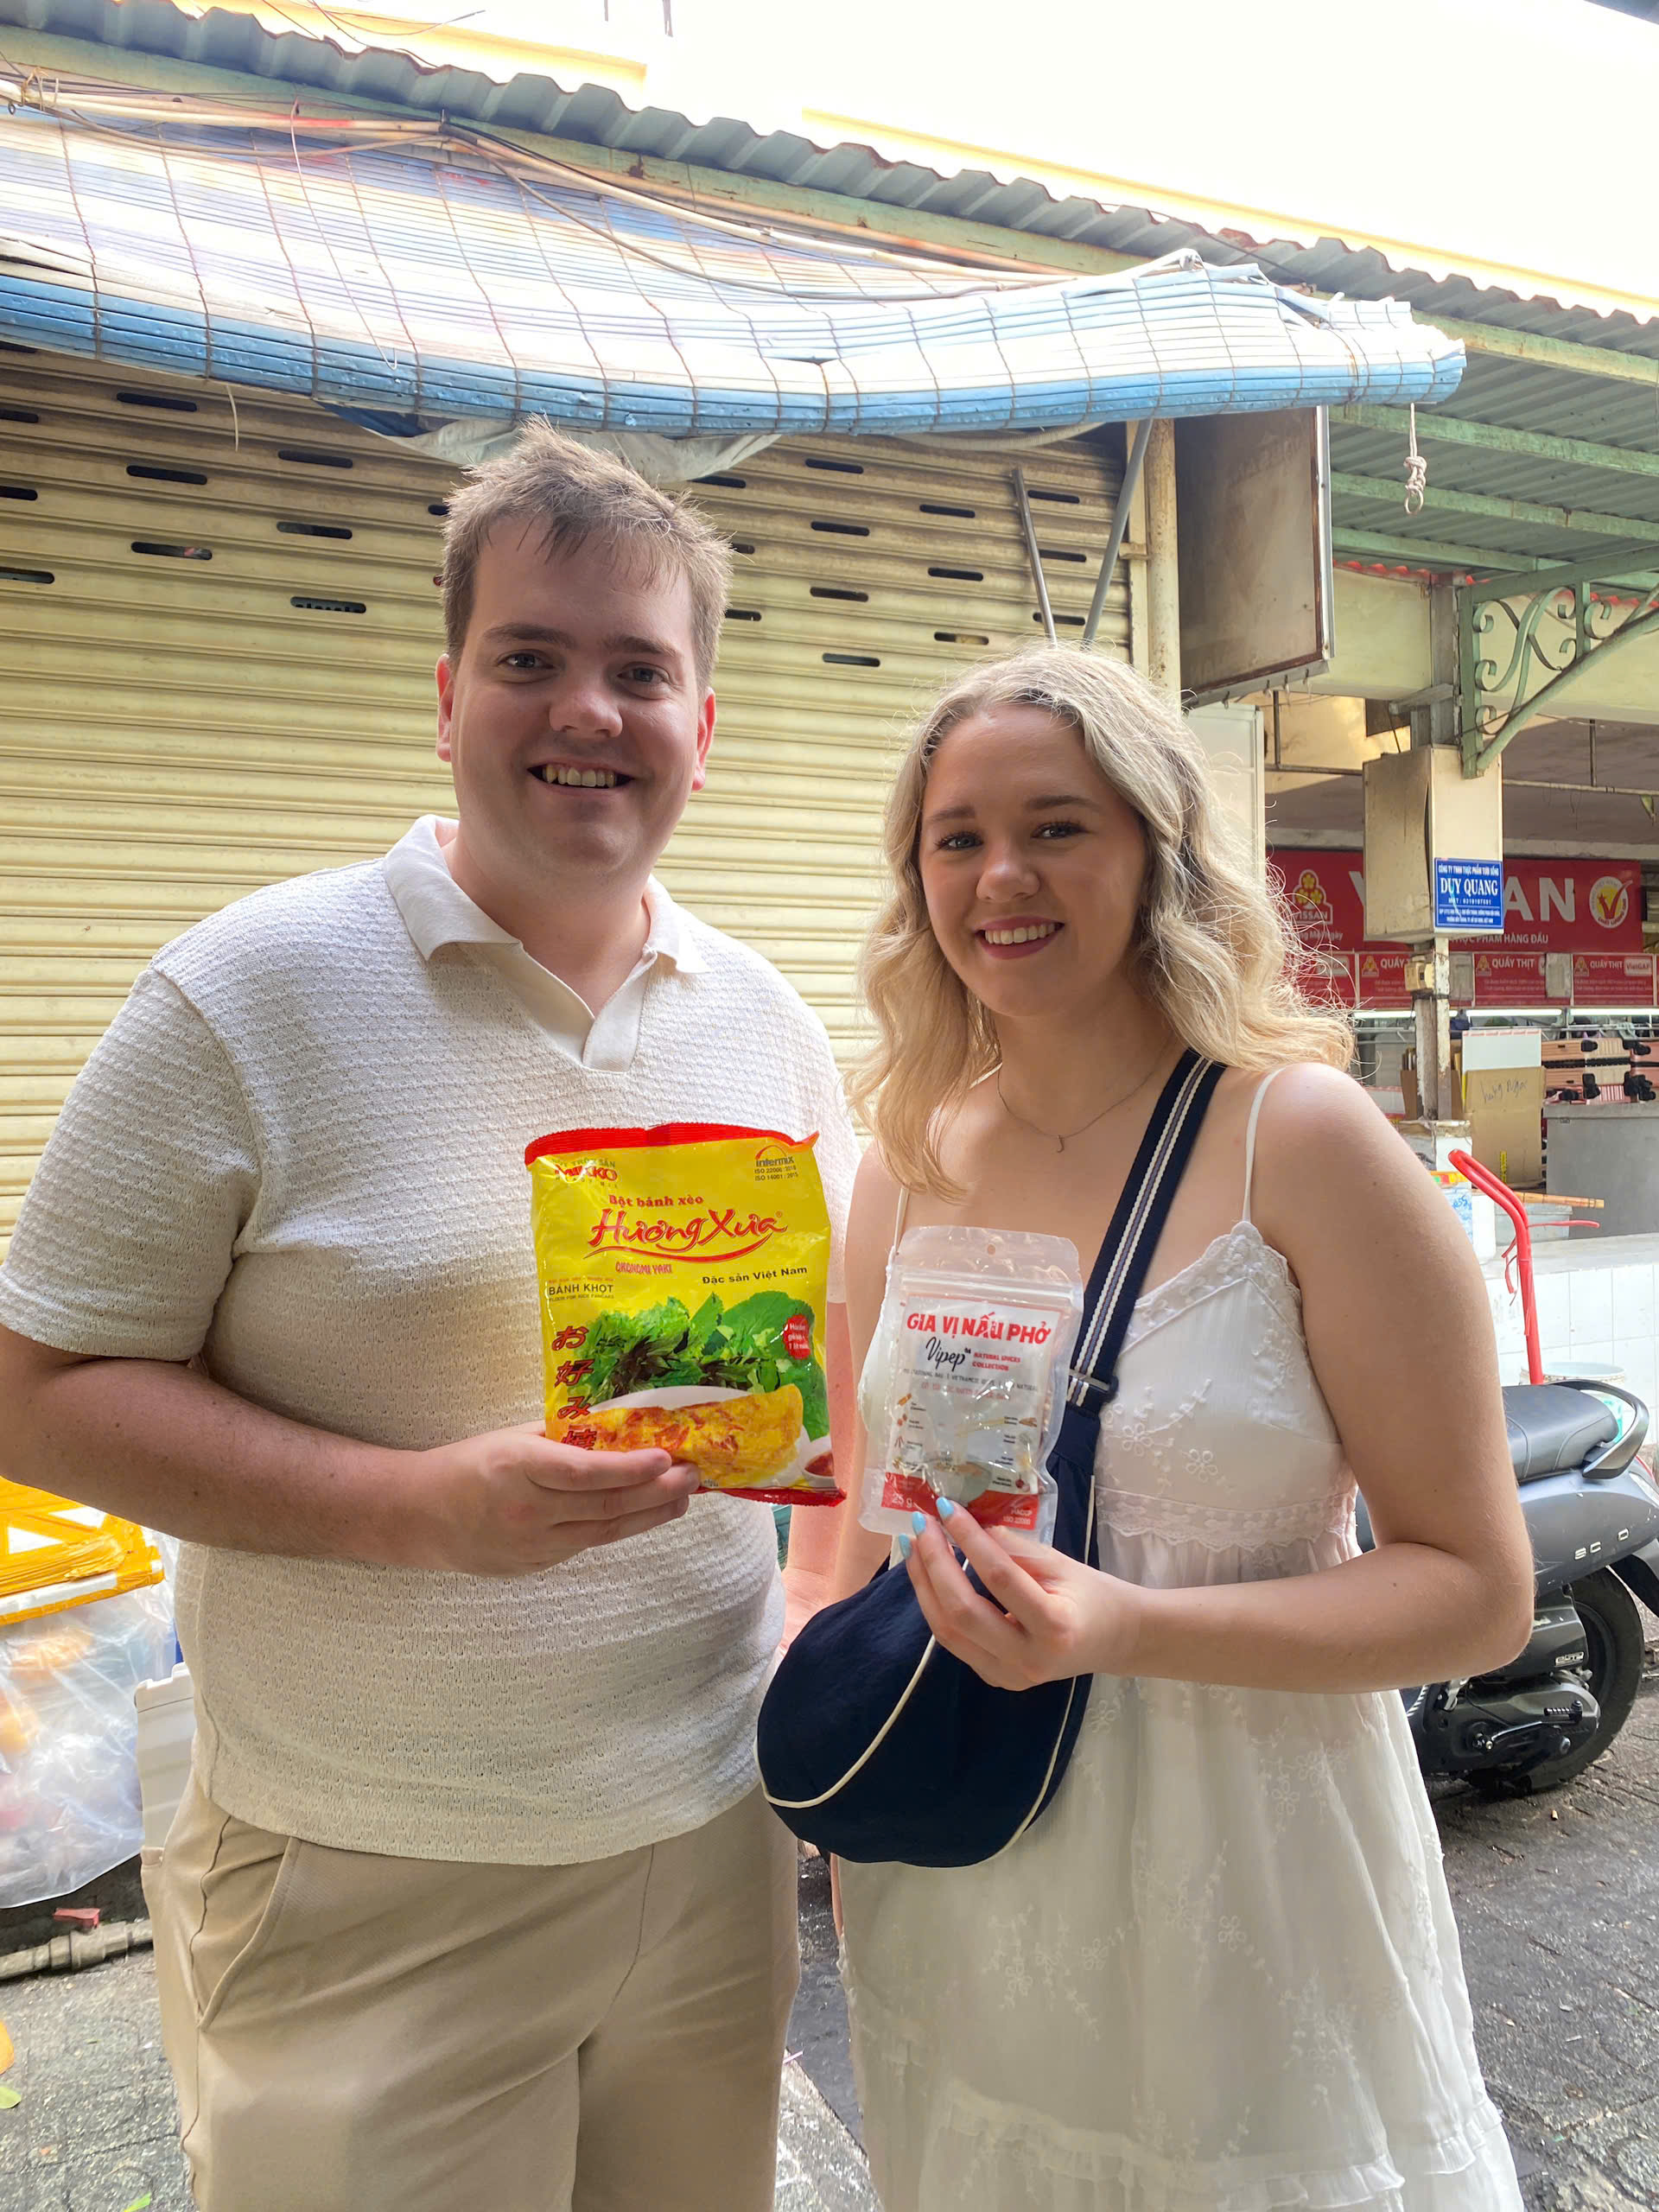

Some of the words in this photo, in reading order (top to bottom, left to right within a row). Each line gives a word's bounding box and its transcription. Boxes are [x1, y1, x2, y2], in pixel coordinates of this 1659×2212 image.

[1440, 878, 1461, 894] DUY
[1464, 879, 1498, 897] QUANG
[609, 1194, 632, 1208] Bột
[637, 1196, 674, 1207] bánh
[678, 1194, 704, 1206] xèo
[653, 1263, 672, 1274] YAKI
[702, 1275, 725, 1286] Đặc
[753, 1270, 777, 1281] Việt
[781, 1266, 807, 1276] Nam
[549, 1282, 580, 1295] BÁNH
[906, 1313, 936, 1332] GIA
[943, 1315, 959, 1338] VỊ
[962, 1312, 1004, 1340] NẤU
[1007, 1320, 1051, 1344] PHỞ
[925, 1336, 965, 1372] Vipep
[972, 1361, 1009, 1372] COLLECTION
